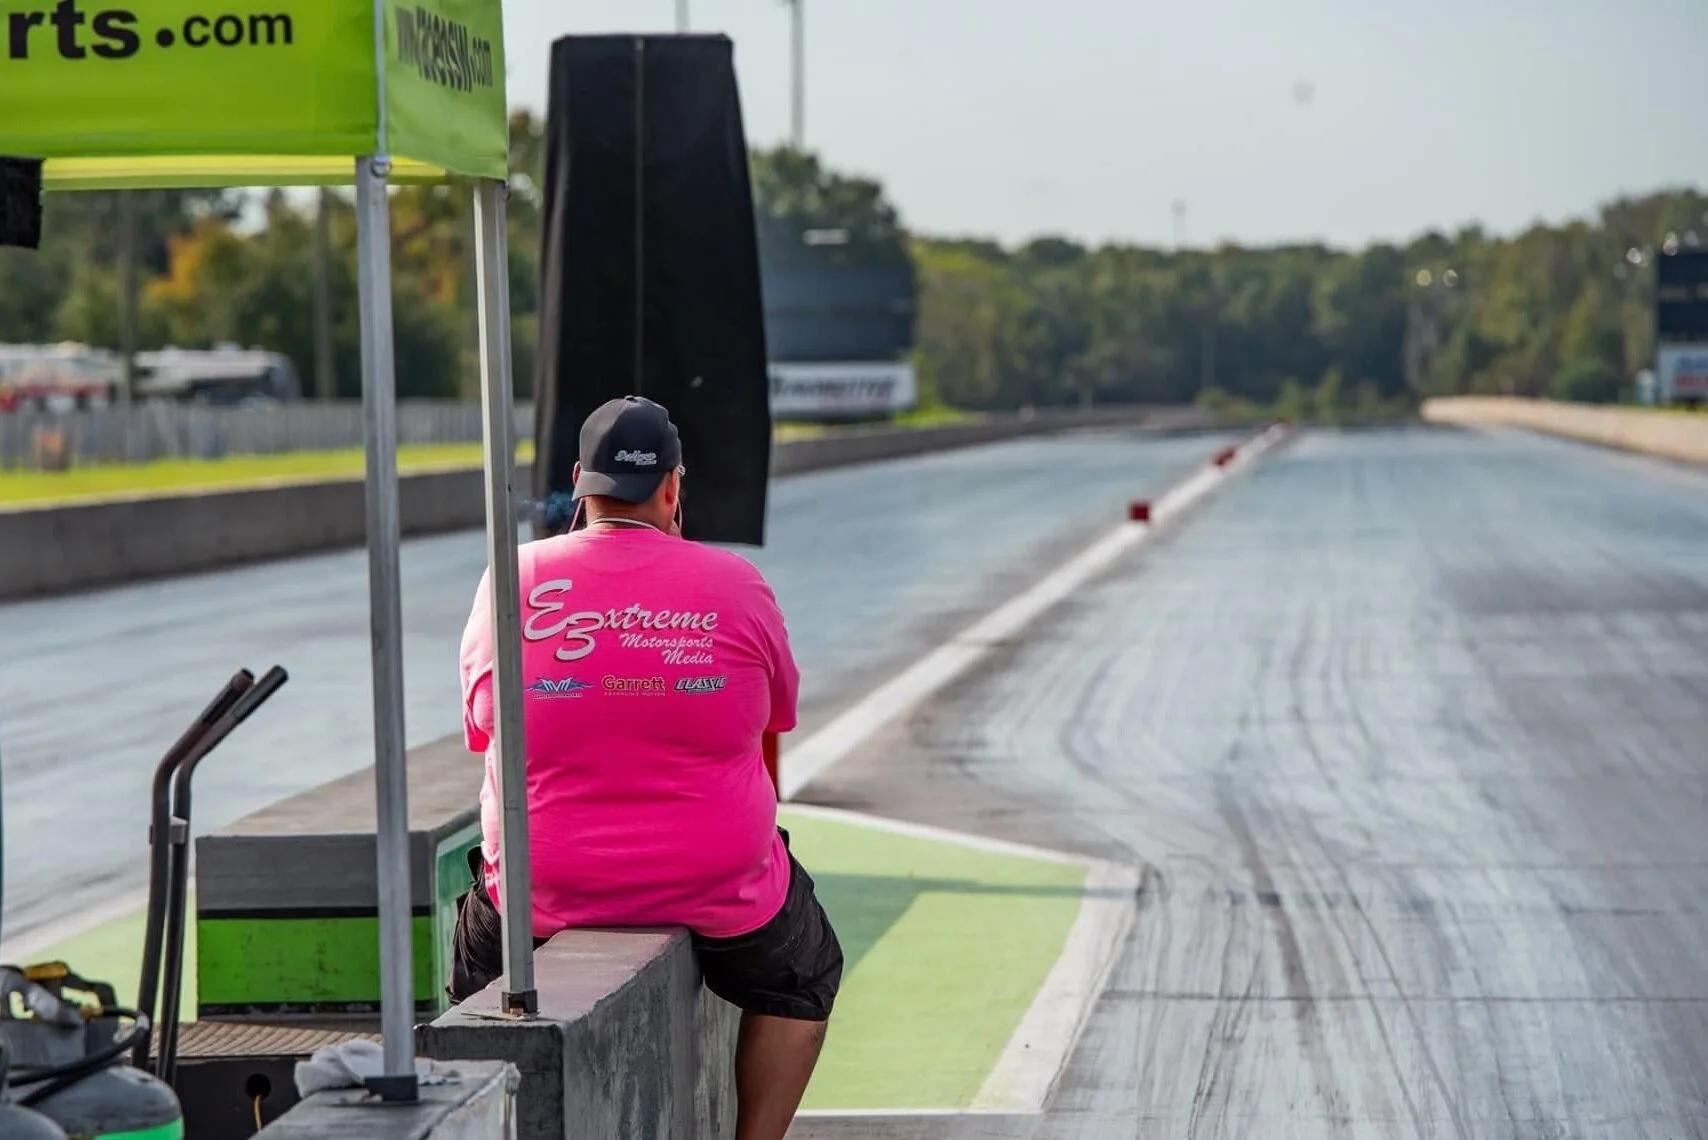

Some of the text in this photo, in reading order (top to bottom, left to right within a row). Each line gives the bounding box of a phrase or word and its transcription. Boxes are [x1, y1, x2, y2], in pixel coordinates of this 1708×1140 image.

[619, 632, 714, 651] Motorsports
[661, 649, 714, 665] Media
[603, 675, 666, 690] Garrett
